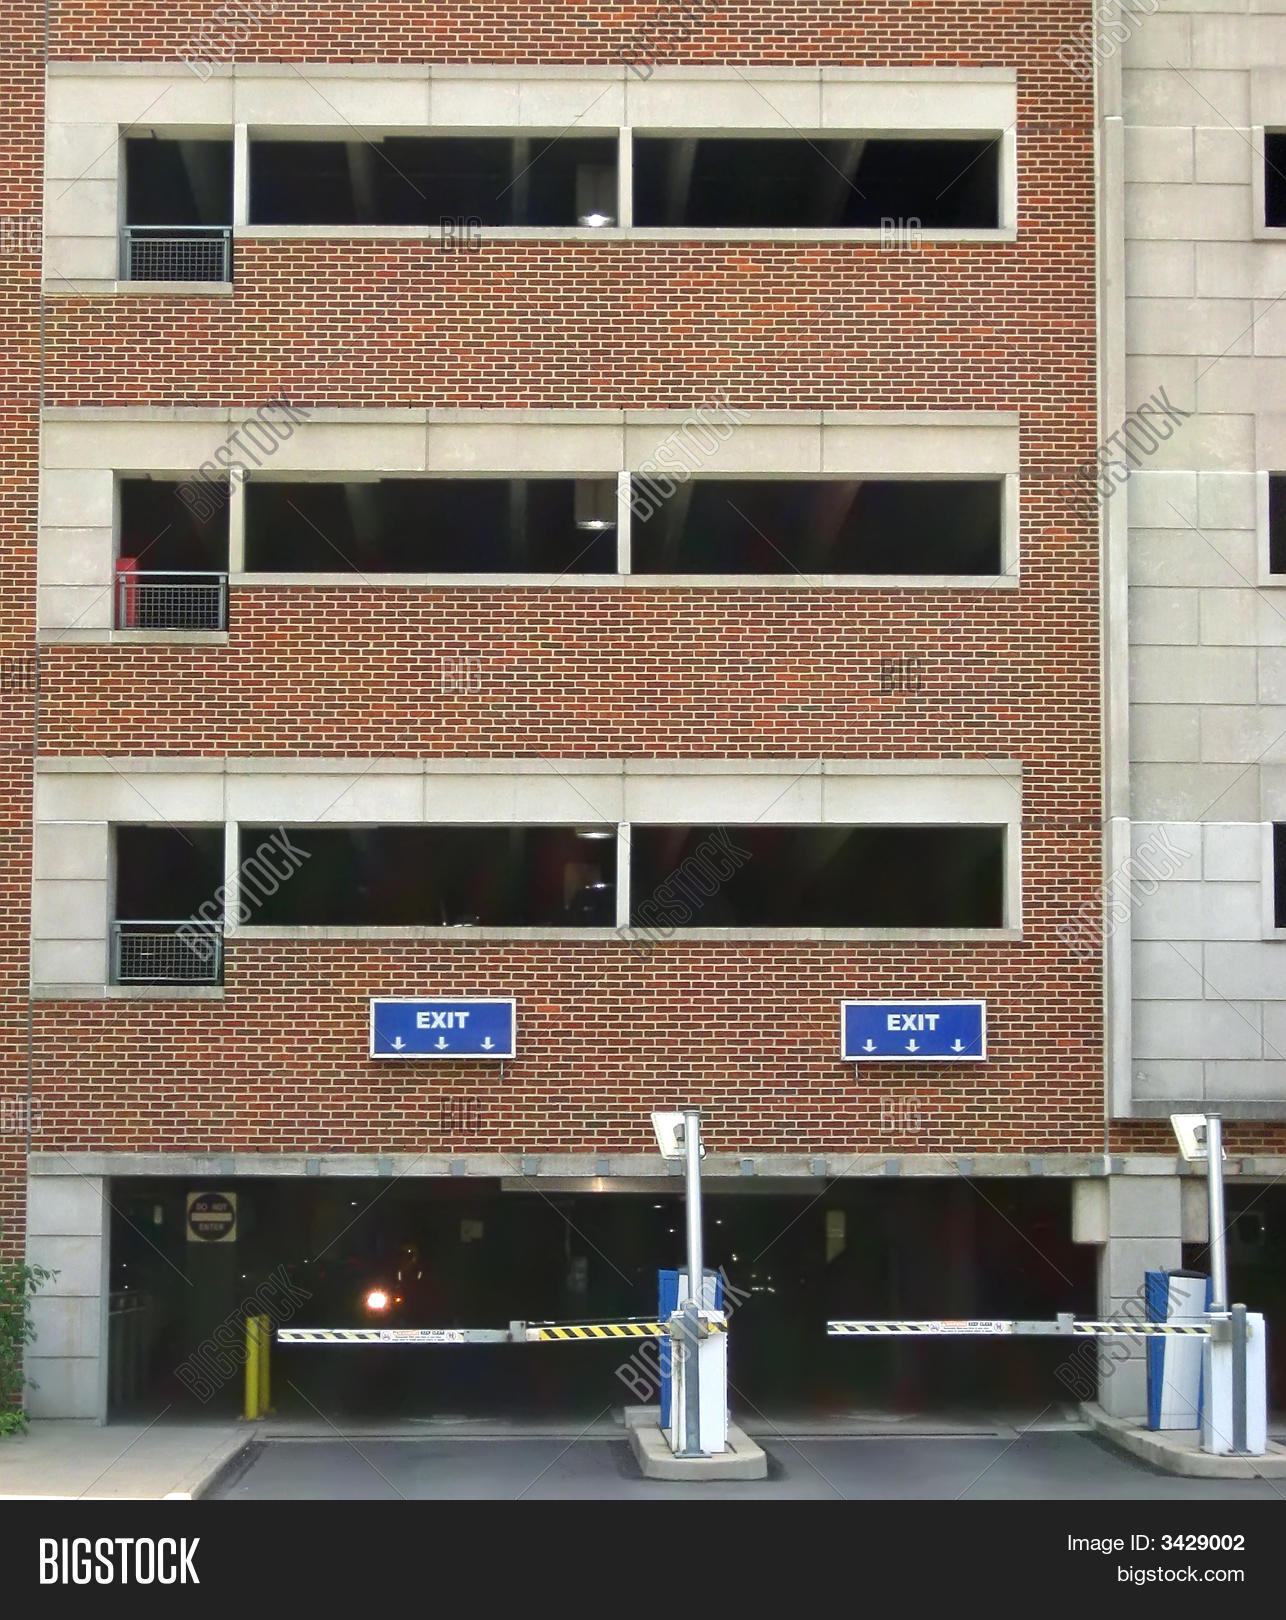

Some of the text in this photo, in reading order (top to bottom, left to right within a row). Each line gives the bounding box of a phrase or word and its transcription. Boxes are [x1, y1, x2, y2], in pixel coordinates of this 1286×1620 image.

[416, 1011, 470, 1029] EXIT
[887, 1013, 940, 1031] EXIT
[195, 1202, 228, 1211] DO NOT
[199, 1223, 225, 1231] ENTER
